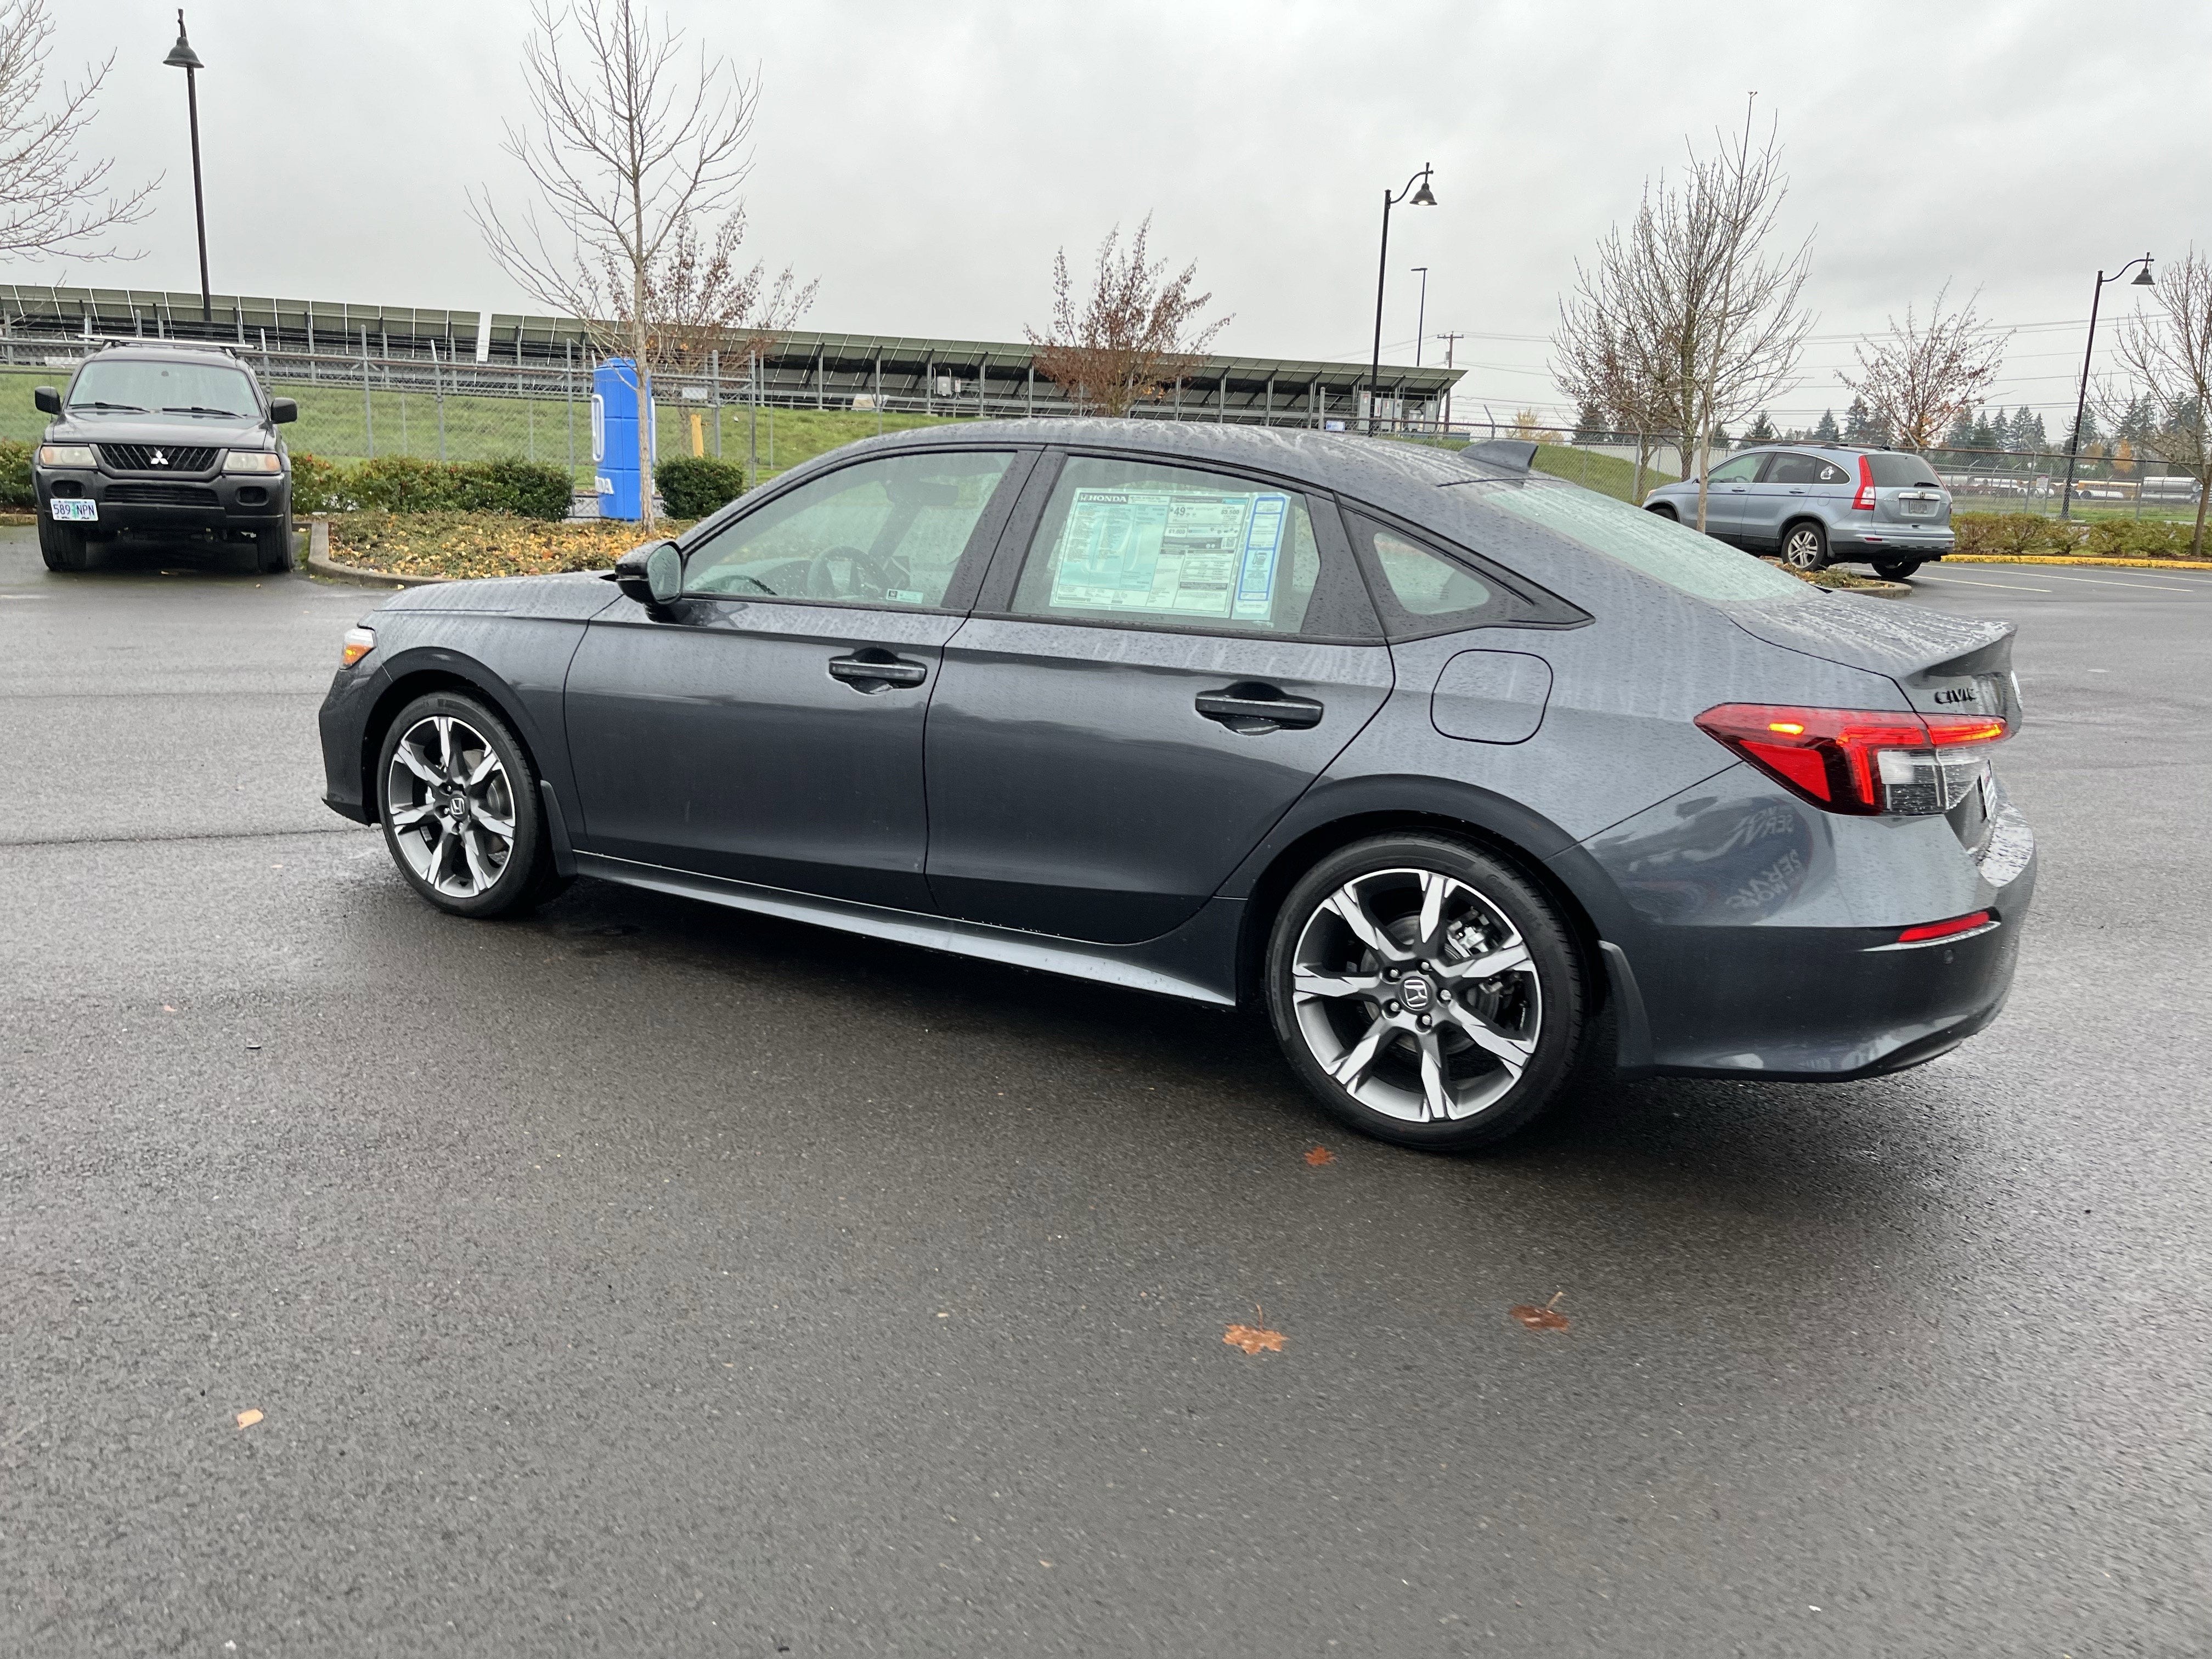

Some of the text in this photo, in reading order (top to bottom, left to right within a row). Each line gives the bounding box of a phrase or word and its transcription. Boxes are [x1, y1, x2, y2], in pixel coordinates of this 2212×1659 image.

[53, 504, 94, 516] 589 NPN
[1934, 688, 1976, 704] CIVIC
